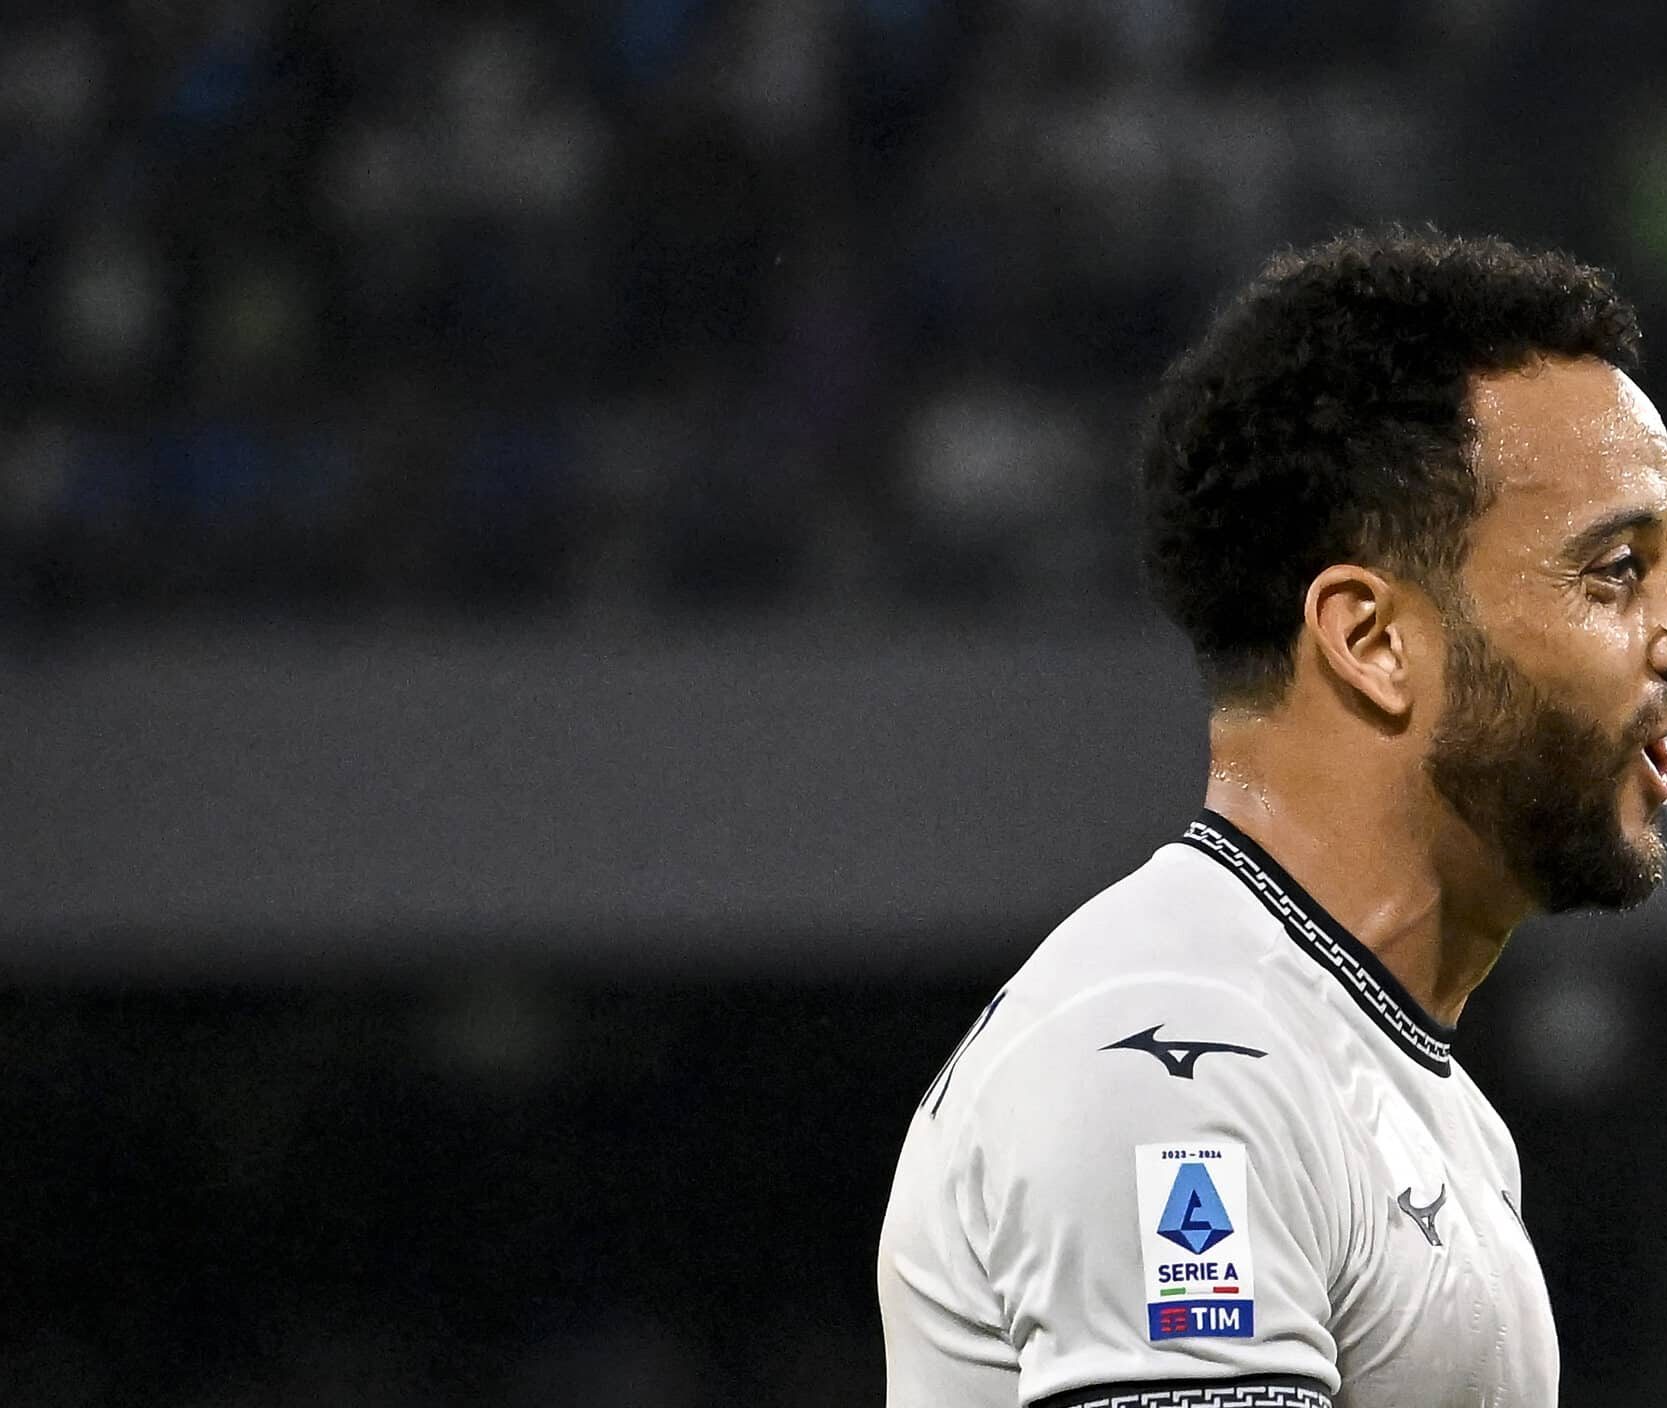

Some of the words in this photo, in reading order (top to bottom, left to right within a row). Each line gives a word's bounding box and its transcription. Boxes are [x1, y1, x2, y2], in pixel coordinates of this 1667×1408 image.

[1158, 1262, 1219, 1283] SERIE
[1224, 1262, 1239, 1280] A
[1191, 1307, 1240, 1331] TIM
